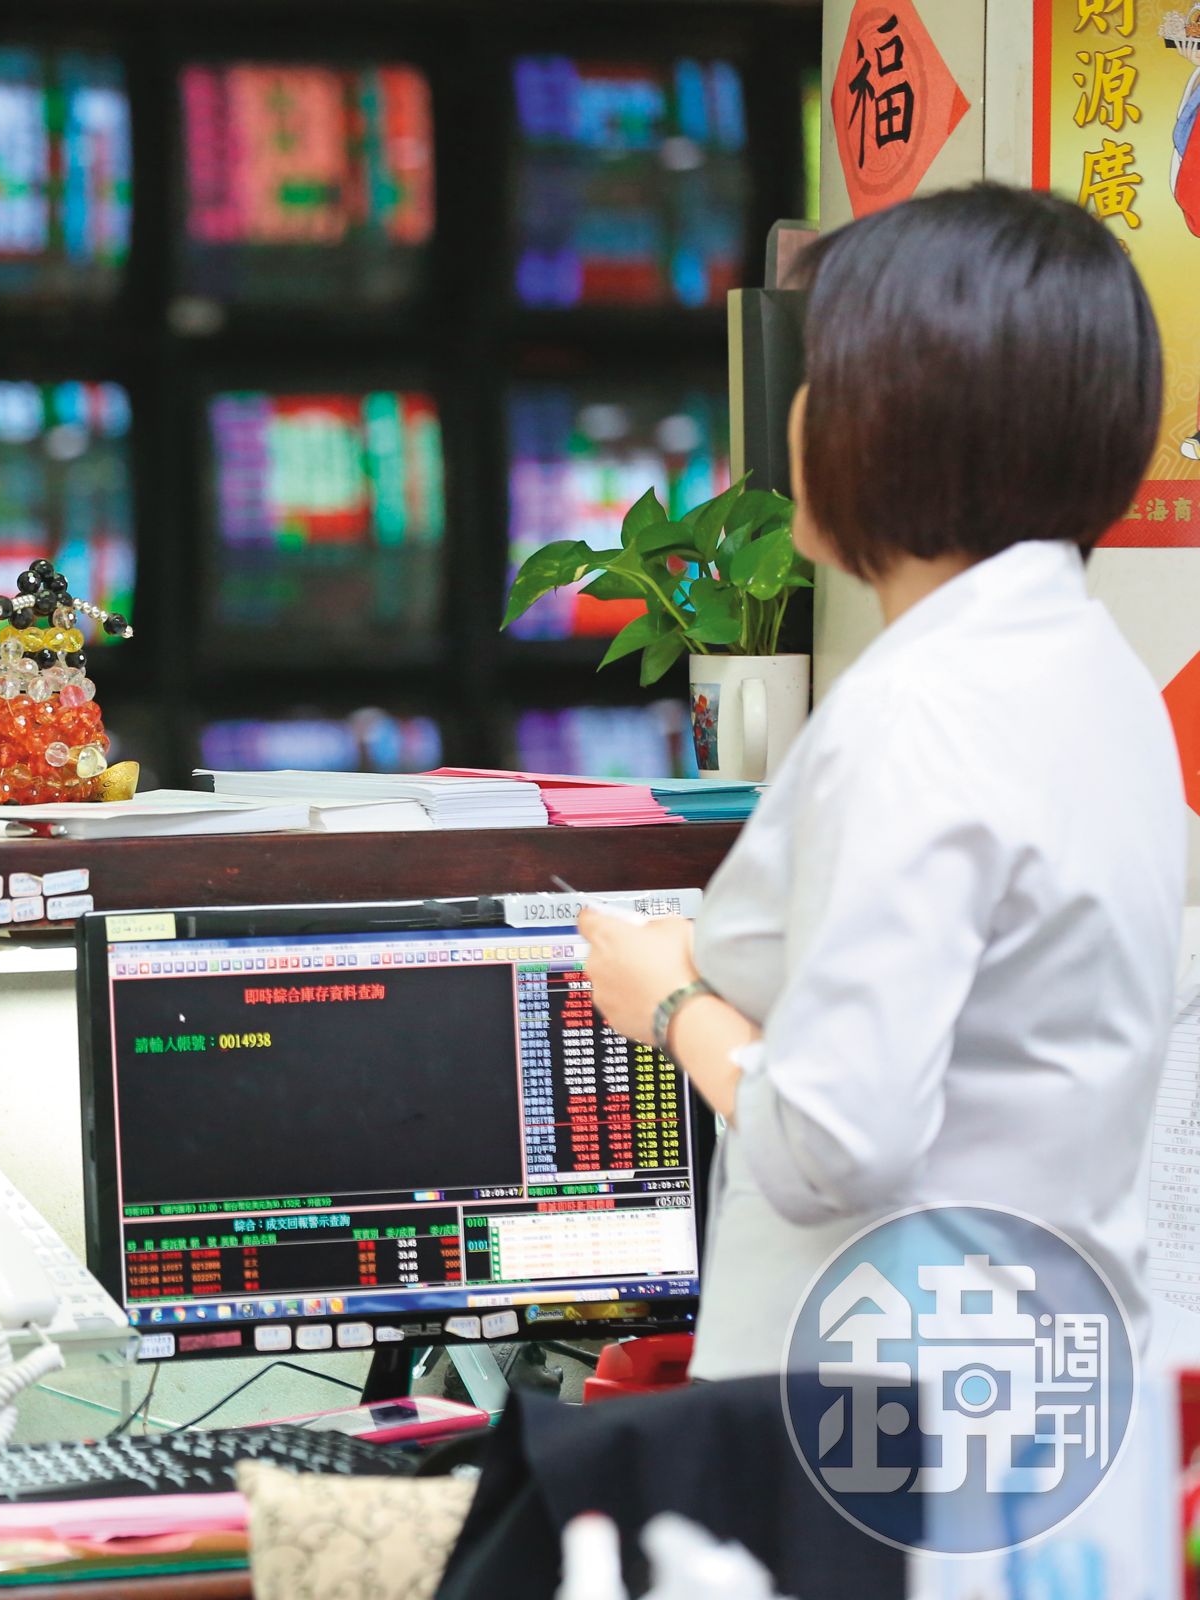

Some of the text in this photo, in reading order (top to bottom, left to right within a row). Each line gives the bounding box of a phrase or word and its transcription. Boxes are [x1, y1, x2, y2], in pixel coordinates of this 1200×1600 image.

[848, 14, 915, 169] 福
[524, 902, 588, 921] 192.168.2
[244, 984, 385, 1004] 即時綜合庫存資料查詢
[656, 1196, 691, 1207] (05/08)
